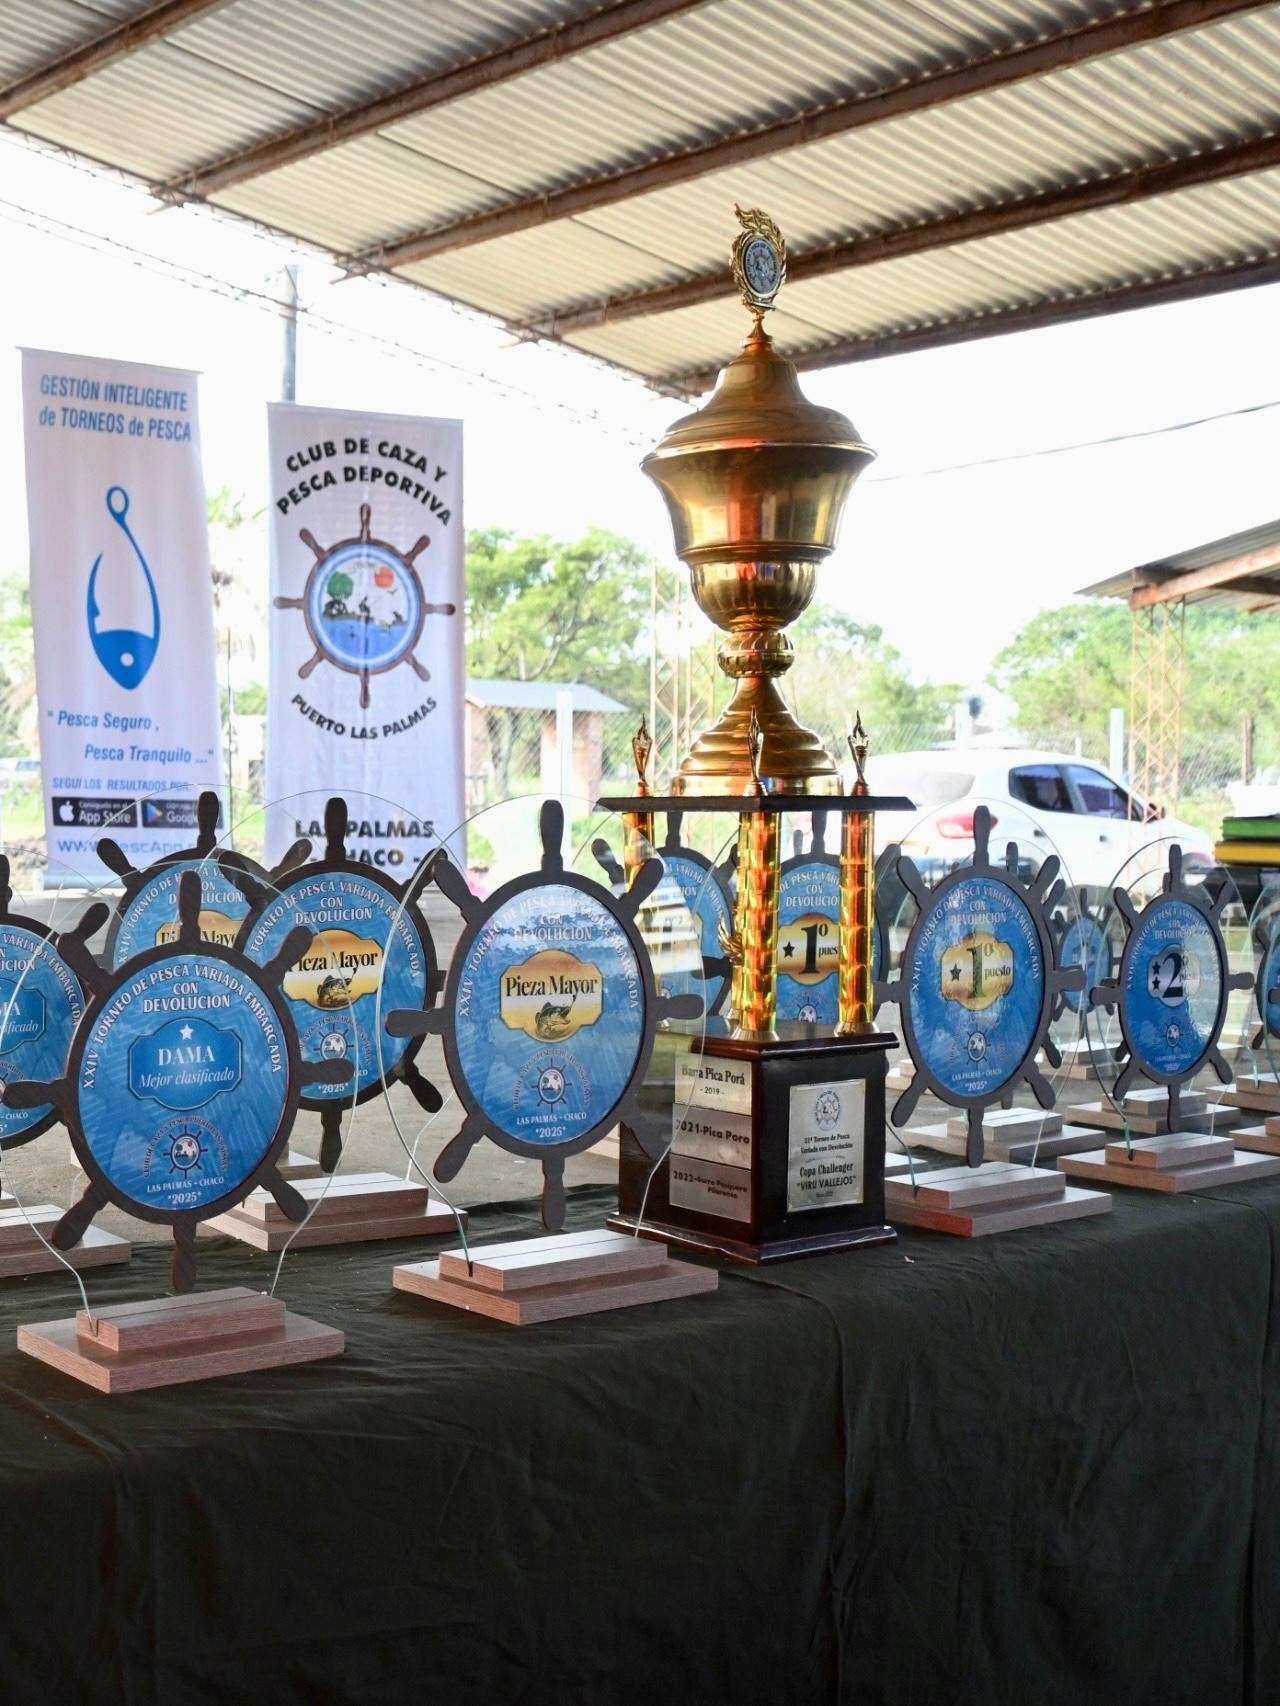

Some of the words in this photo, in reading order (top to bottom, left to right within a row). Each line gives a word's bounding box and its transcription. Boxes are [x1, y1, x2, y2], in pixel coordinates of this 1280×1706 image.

[103, 381, 189, 412] INTELIGENTE
[39, 406, 56, 426] de
[61, 407, 125, 434] TORNEOS
[128, 416, 144, 437] de
[148, 418, 192, 442] PESCA
[286, 440, 337, 472] CLUB
[344, 438, 370, 455] DE
[378, 441, 428, 474] CAZA
[434, 464, 448, 483] Y
[276, 470, 338, 516] PESCA
[343, 465, 452, 526] DEPORTIVA
[291, 693, 346, 736] PUERTO
[350, 726, 378, 740] LAS
[382, 696, 438, 738] PALMAS
[84, 744, 125, 761] Pesca
[84, 778, 102, 790] LOS
[107, 779, 167, 792] RESULTADOS
[79, 811, 100, 824] App
[345, 820, 435, 838] PALMAS
[319, 897, 343, 908] CON
[785, 895, 839, 907] DEVOLUCIO
[969, 900, 986, 911] CON
[250, 905, 284, 953] TORNEO
[299, 882, 336, 901] PESCA
[339, 881, 384, 909] VARIADA
[294, 908, 373, 925] DEVOLUCION
[459, 975, 475, 1017] XXIV
[468, 920, 503, 973] TORNEO
[3, 933, 49, 961] VARIADA
[47, 955, 81, 1028] EMBARCADA
[172, 982, 199, 995] CON
[505, 975, 546, 997] Pieza
[549, 975, 598, 997] Mayor
[143, 994, 232, 1013] DEVOLUCION
[83, 1050, 101, 1089] XXIV
[93, 993, 132, 1046] TORNEO
[131, 979, 149, 997] DE
[150, 964, 190, 985] PESCA
[194, 964, 246, 997] VARIADA
[244, 991, 282, 1073] EMBARCADA
[158, 1045, 216, 1066] DAMA
[138, 1072, 174, 1090] Mejor
[175, 1069, 235, 1085] clasificado
[704, 1067, 724, 1082] Pica
[724, 1069, 745, 1086] Porá
[531, 1113, 558, 1124] PALMAS
[799, 1166, 816, 1178] Copa
[817, 1162, 854, 1175] Challenger
[147, 1183, 161, 1193] LAS
[162, 1180, 193, 1191] PALMAS
[199, 1176, 225, 1187] CHACO
